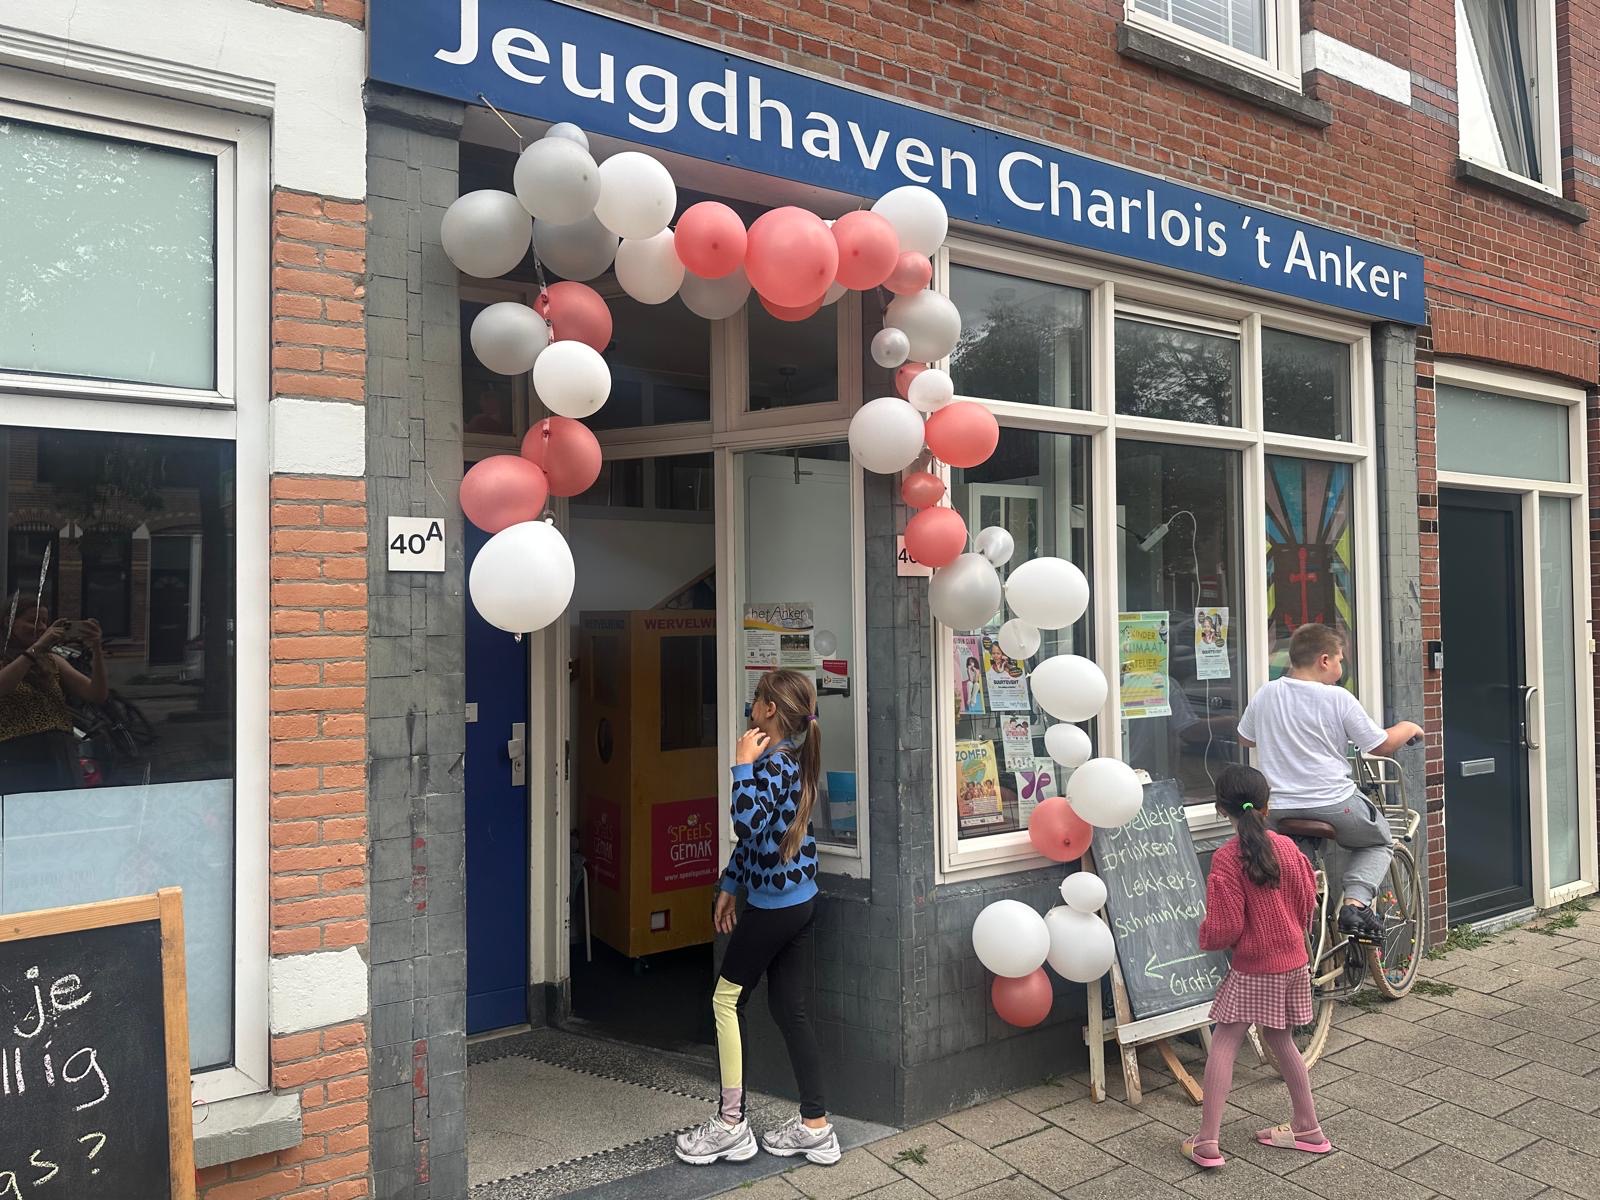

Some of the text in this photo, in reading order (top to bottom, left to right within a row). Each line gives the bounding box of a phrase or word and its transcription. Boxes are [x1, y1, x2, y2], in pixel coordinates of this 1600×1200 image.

[434, 0, 978, 196] Jeugdhaven
[998, 150, 1228, 258] Charlois
[1283, 230, 1407, 301] Anker
[1102, 839, 1178, 872] Drinken
[1114, 898, 1207, 939] Schminken
[13, 966, 92, 1038] je
